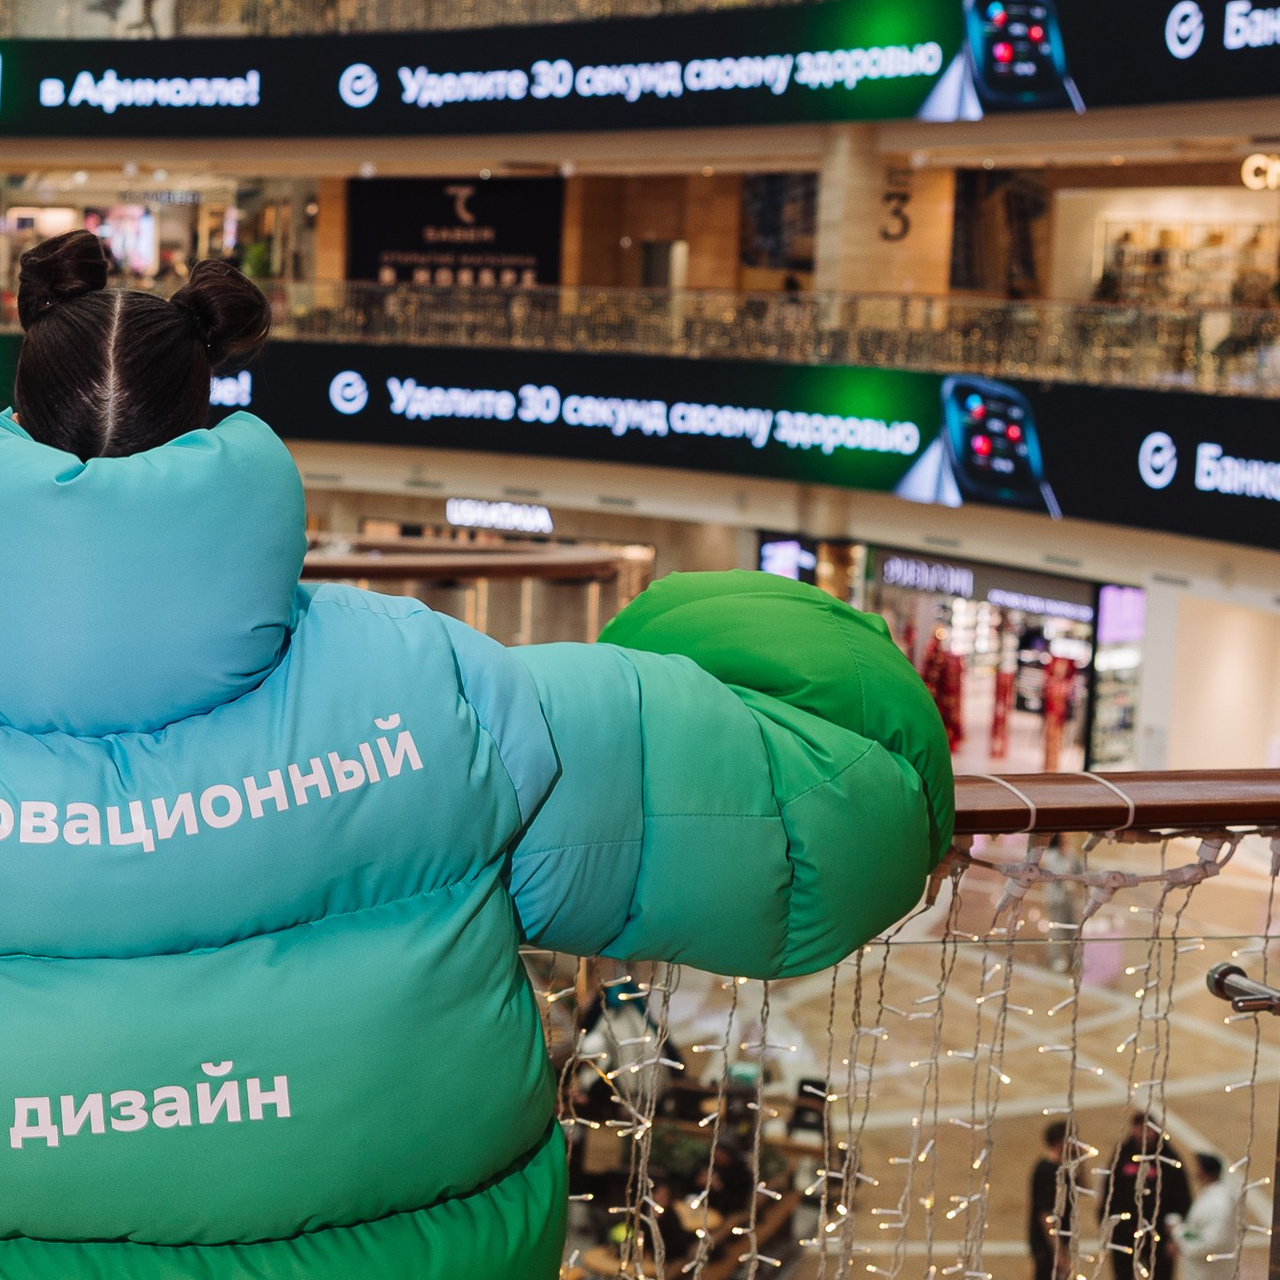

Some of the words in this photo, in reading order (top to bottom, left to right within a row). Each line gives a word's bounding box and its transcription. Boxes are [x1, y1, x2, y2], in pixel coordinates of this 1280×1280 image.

[39, 78, 66, 107] в
[67, 69, 261, 114] Афимолле!
[398, 65, 529, 108] Уделите
[531, 59, 573, 99] 30
[574, 60, 682, 102] секунд
[684, 53, 794, 95] своему
[794, 41, 943, 89] здоровью
[880, 192, 911, 242] 3
[386, 376, 516, 421] Уделите
[518, 384, 561, 424] 30
[562, 394, 668, 436] секунд
[669, 402, 773, 448] своему
[773, 410, 920, 455] здоровью
[9, 1060, 291, 1149] дизайн
